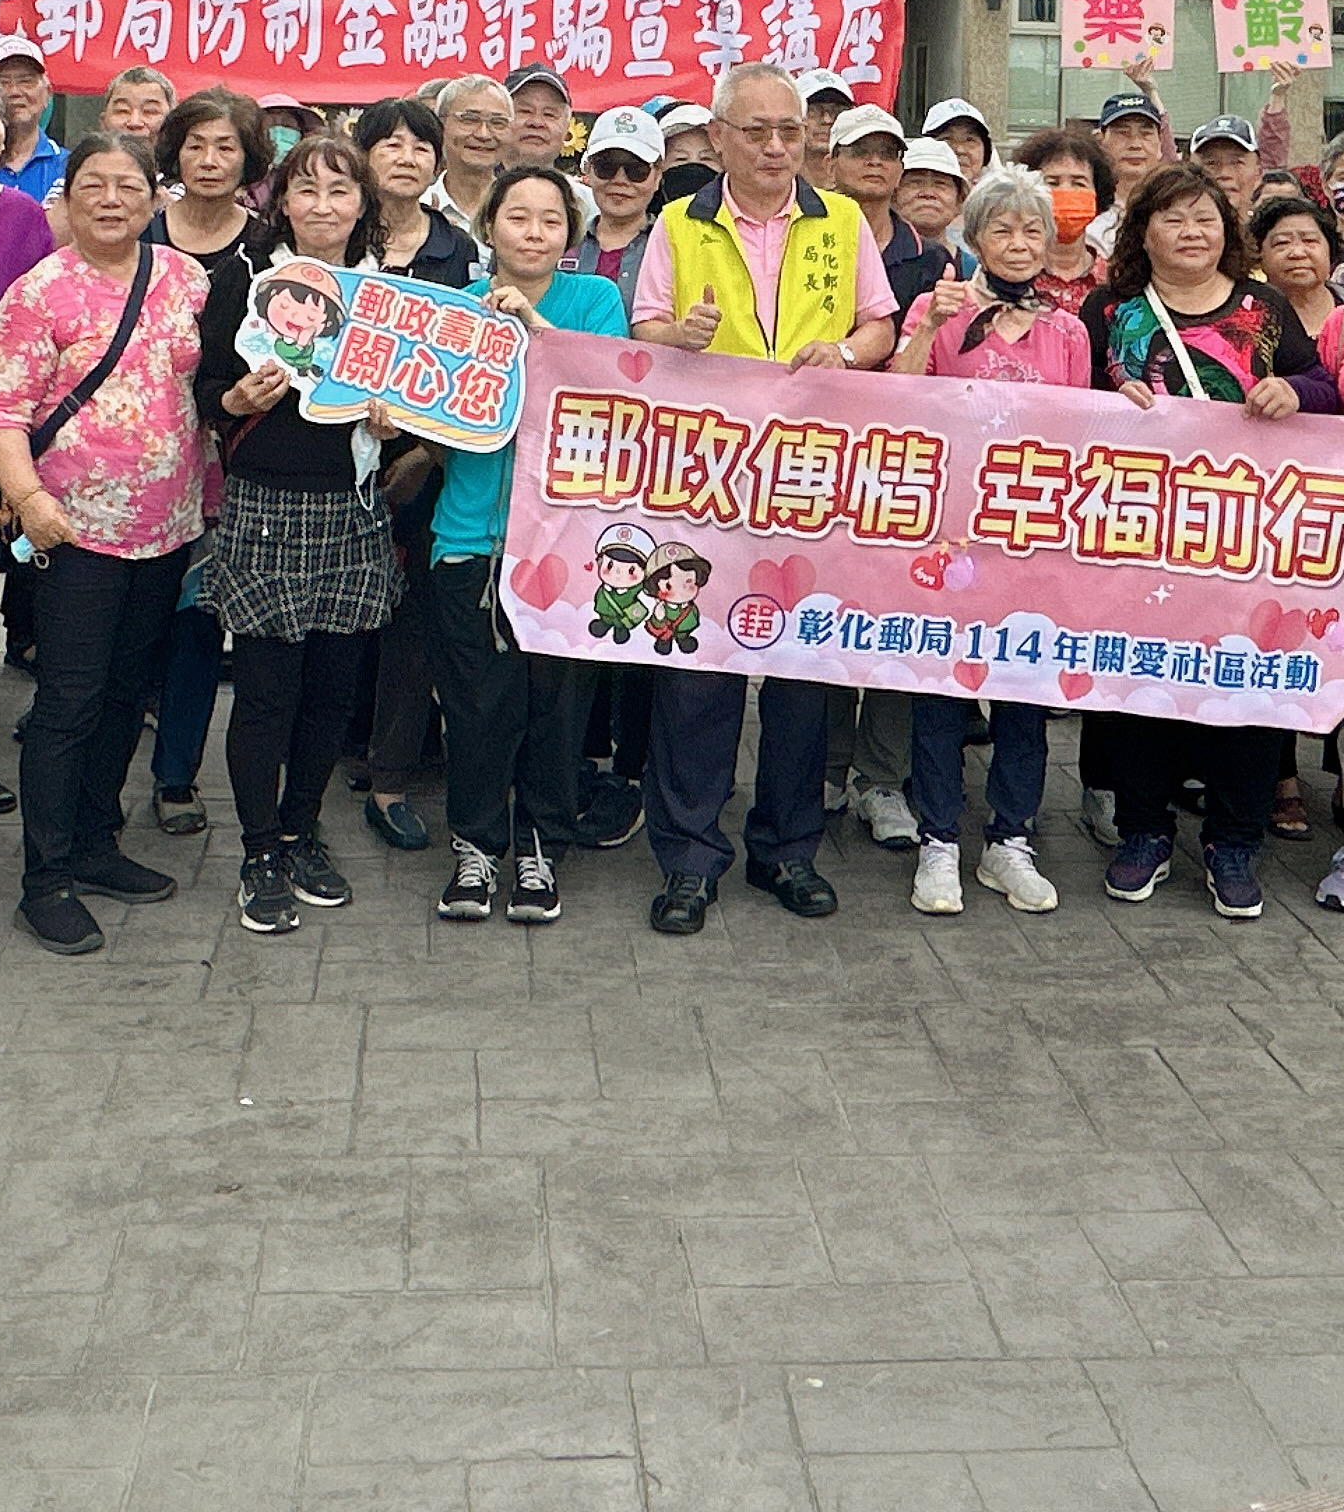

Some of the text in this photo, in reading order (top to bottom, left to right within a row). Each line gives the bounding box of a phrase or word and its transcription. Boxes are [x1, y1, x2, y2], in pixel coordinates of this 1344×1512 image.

[353, 282, 517, 367] 郵政壽險
[335, 326, 506, 422] 關心您
[550, 391, 944, 542] 郵政傳情
